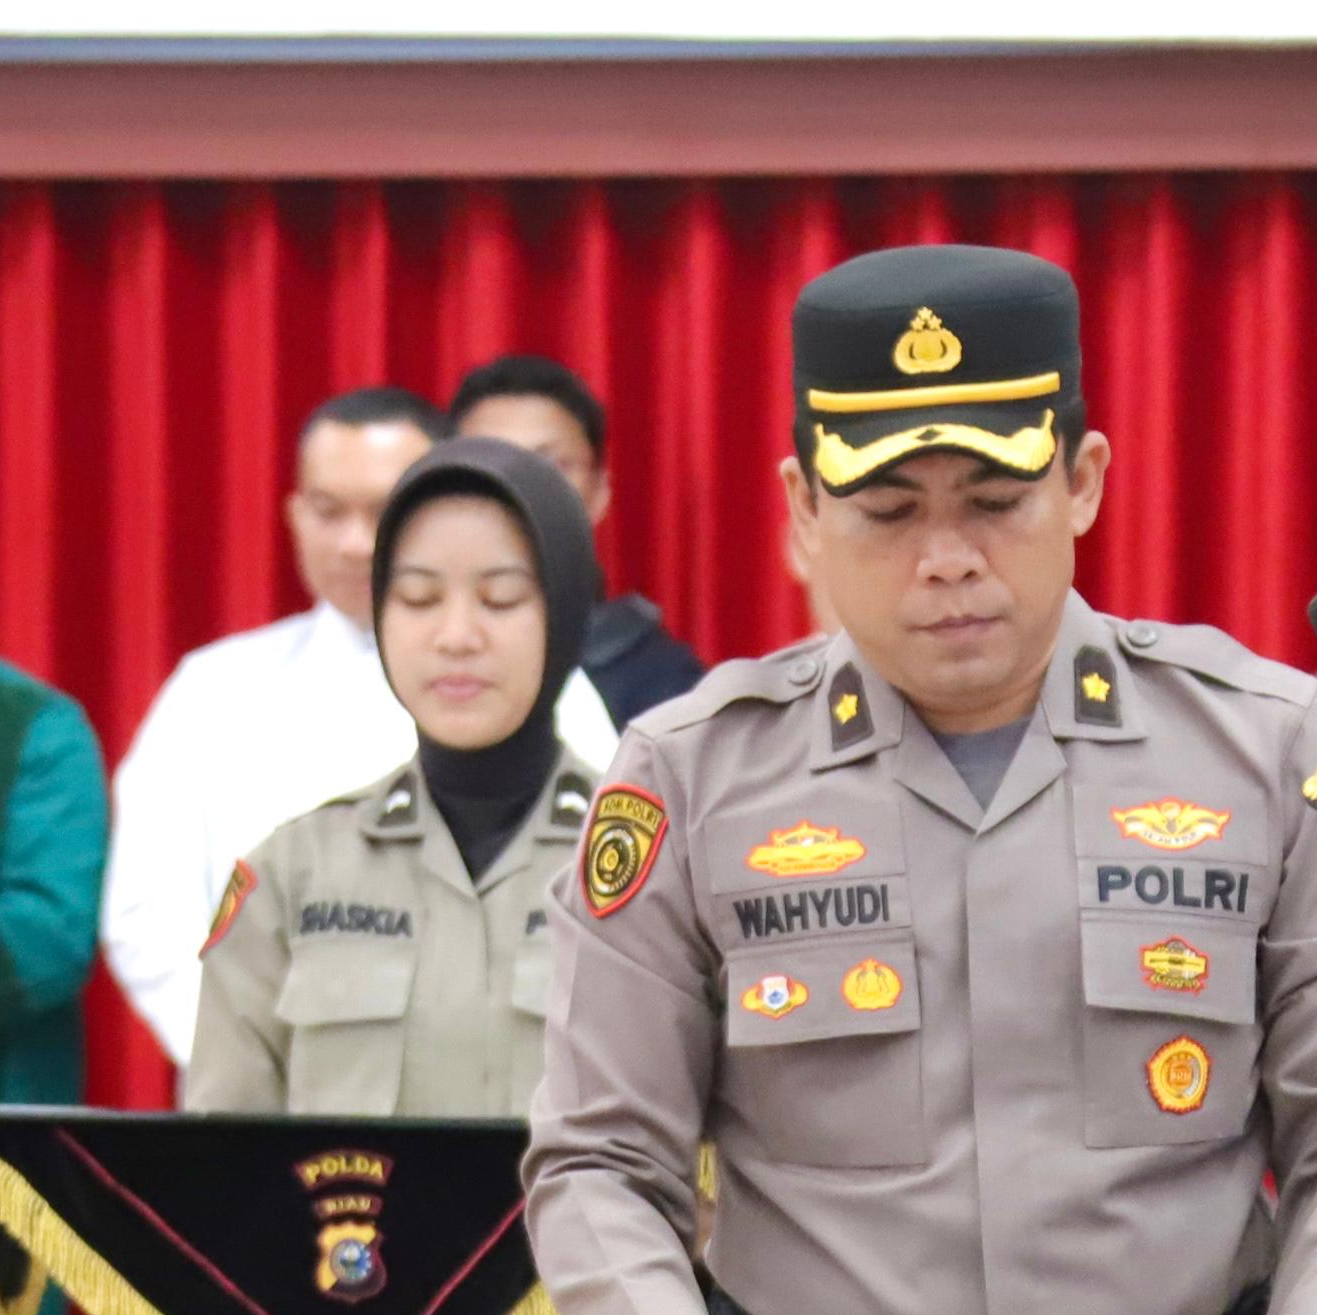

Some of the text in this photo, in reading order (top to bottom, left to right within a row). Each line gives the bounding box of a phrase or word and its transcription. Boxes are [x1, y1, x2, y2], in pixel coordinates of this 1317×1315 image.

[733, 884, 891, 939] WAHYUDI
[1097, 865, 1250, 913] POLRI
[305, 1155, 383, 1184] POLDA
